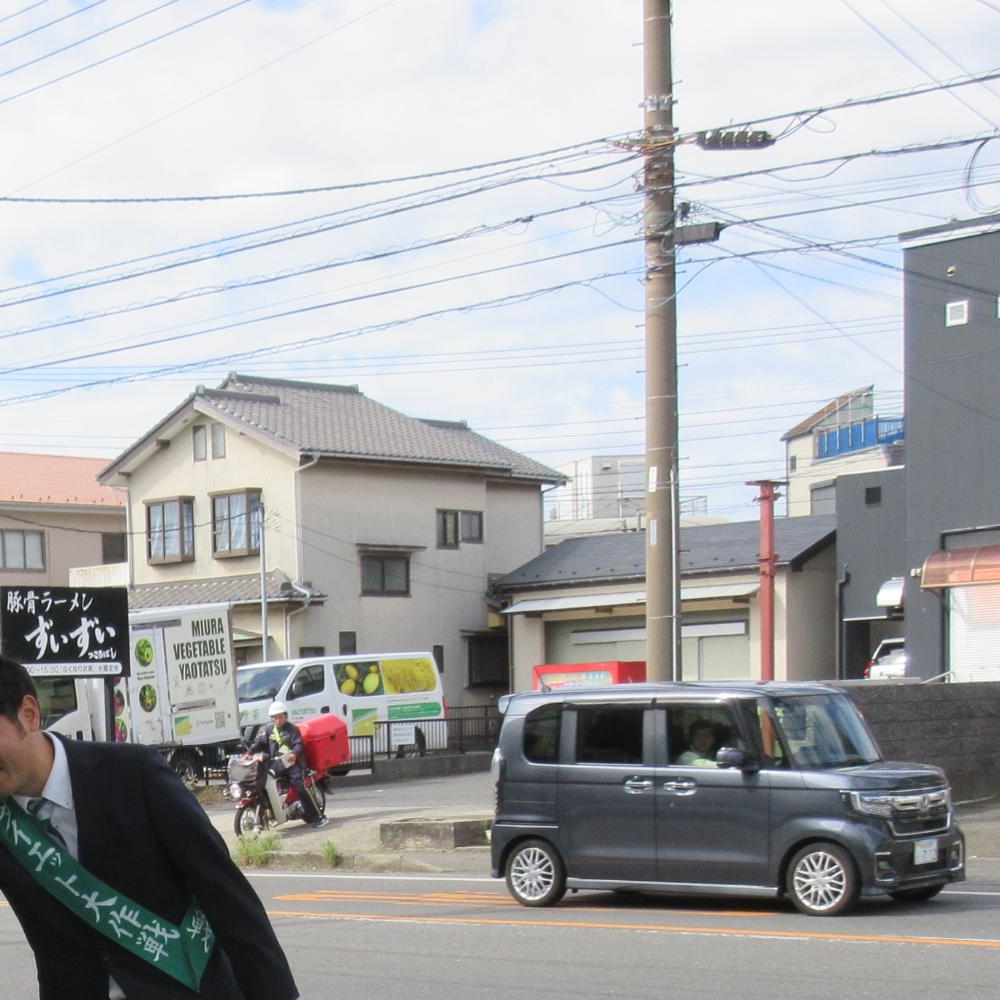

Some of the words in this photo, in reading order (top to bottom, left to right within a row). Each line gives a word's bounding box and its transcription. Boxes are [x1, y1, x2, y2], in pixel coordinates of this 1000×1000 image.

[7, 590, 94, 614] 豚骨ラーメン
[24, 615, 116, 660] ずいずい
[191, 617, 224, 637] MIURA
[173, 638, 226, 660] VEGETABLE
[178, 658, 227, 680] YAOTATSU
